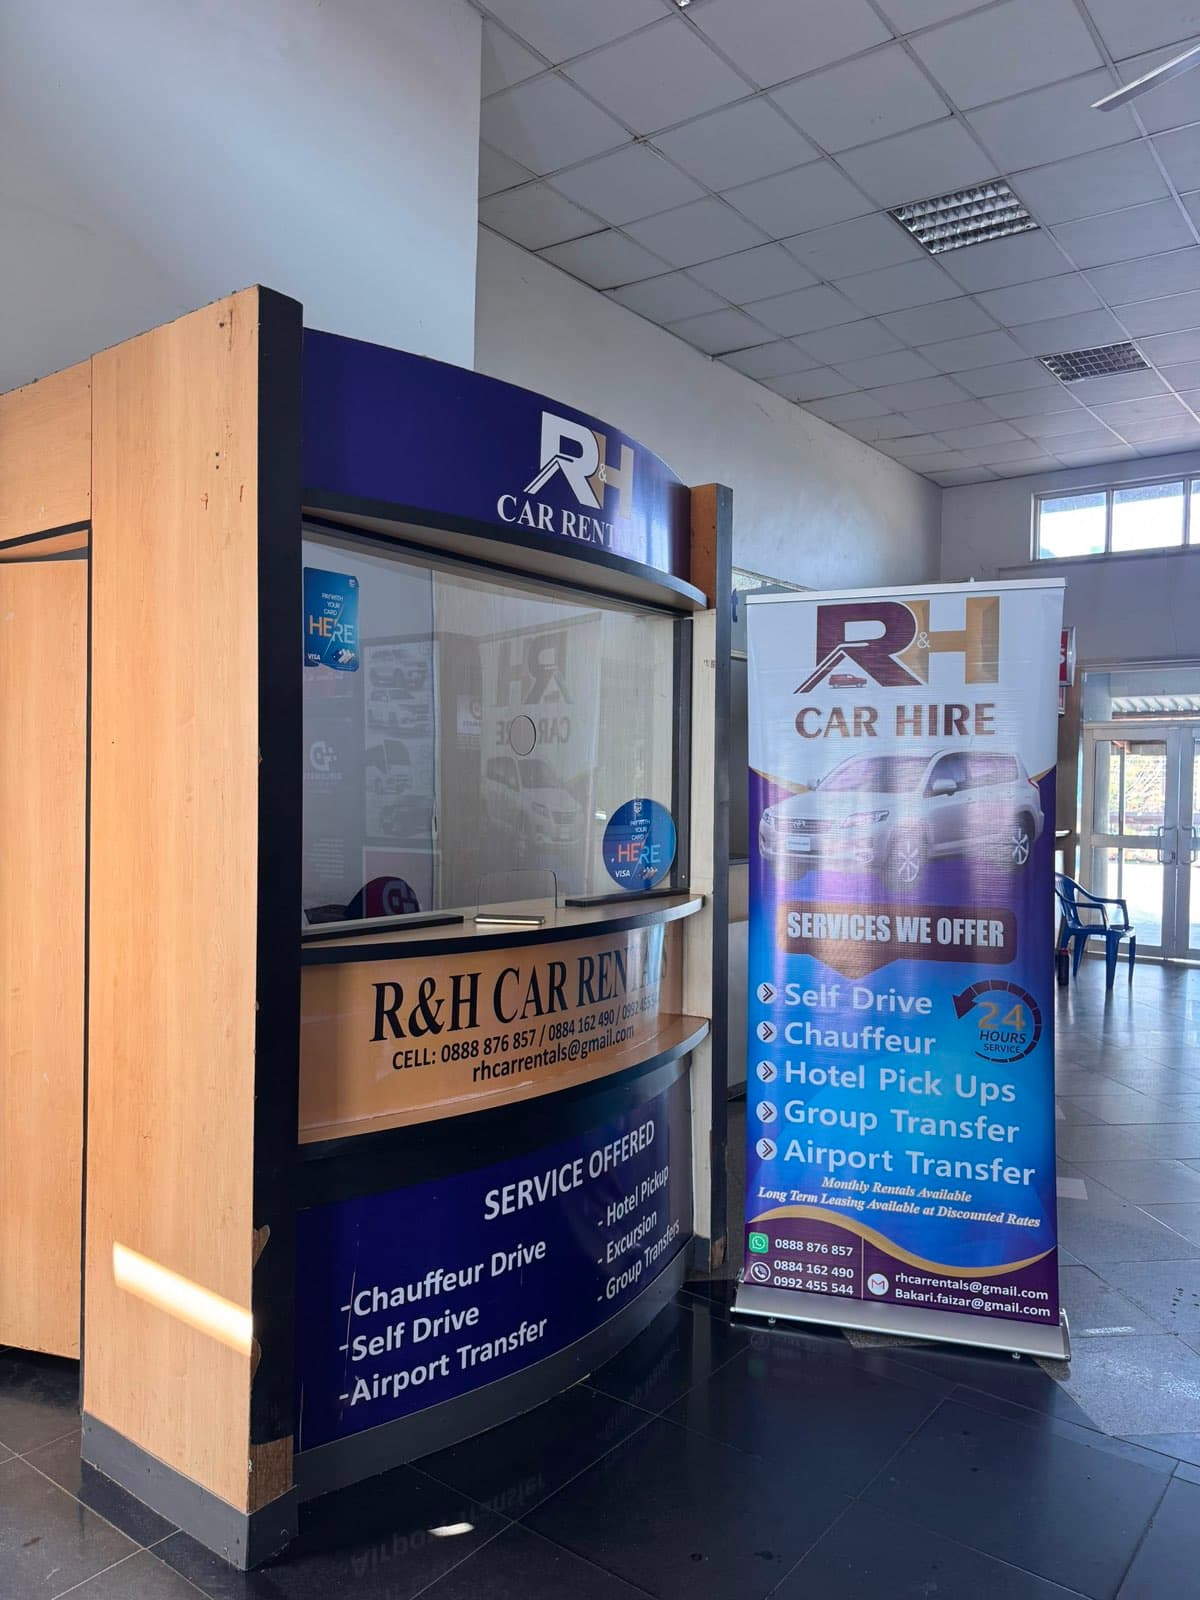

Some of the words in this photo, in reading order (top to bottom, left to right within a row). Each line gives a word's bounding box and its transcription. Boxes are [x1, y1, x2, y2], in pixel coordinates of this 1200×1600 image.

[497, 494, 555, 533] CAR
[309, 614, 356, 644] HERE
[793, 596, 1000, 694] R&H
[795, 706, 879, 739] CAR
[895, 703, 996, 737] HIRE
[617, 843, 661, 864] HERE
[615, 869, 631, 878] VISA
[787, 912, 891, 942] SERVICES
[896, 916, 931, 943] WE
[937, 918, 1005, 948] OFFER
[370, 972, 482, 1042] R&H
[493, 961, 568, 1023] CAR
[784, 983, 840, 1008] Self
[853, 986, 933, 1015] Drive
[978, 1002, 1027, 1031] 24
[392, 1048, 437, 1071] CELL:
[441, 1039, 479, 1064] 0888
[483, 1033, 509, 1056] 876
[513, 1029, 537, 1051] 857
[548, 1020, 576, 1042] 0884
[578, 1015, 596, 1033] 162
[599, 1009, 614, 1027] 490
[473, 1024, 635, 1082] rhcarrentals@gmail.com
[784, 1021, 936, 1055] Chauffeur
[979, 1030, 1027, 1044] HOURS
[984, 1043, 1021, 1053] SERVICE
[784, 1060, 865, 1089] Hotel
[879, 1068, 942, 1096] Pick
[954, 1073, 1017, 1106] Ups
[784, 1100, 878, 1136] Group
[890, 1109, 1020, 1144] Transfer
[484, 1158, 584, 1221] SERVICE
[588, 1119, 655, 1178] OFFERED
[784, 1139, 893, 1173] Airport
[905, 1150, 1036, 1186] Transfer
[607, 1185, 639, 1227] Hotel
[641, 1165, 669, 1202] Pickup
[758, 1186, 788, 1203] Long
[789, 1190, 818, 1203] Term
[820, 1193, 866, 1211] Leasing
[867, 1198, 920, 1215] Available
[922, 1206, 935, 1216] at
[936, 1206, 1005, 1224] Discounted
[1005, 1213, 1041, 1228] Rates
[821, 1176, 870, 1194] Monthly
[872, 1182, 915, 1196] Rentals
[917, 1187, 973, 1203] Available
[607, 1211, 657, 1264] Excursion
[775, 1238, 804, 1251] 0888
[806, 1241, 829, 1254] 876
[831, 1244, 854, 1257] 857
[491, 1241, 547, 1278] Drive
[606, 1259, 642, 1300] Group
[644, 1219, 680, 1268] Transfers
[773, 1259, 804, 1273] 0884
[806, 1263, 829, 1276] 162
[831, 1266, 855, 1279] 490
[773, 1275, 804, 1289] 0992
[806, 1279, 829, 1292] 455
[831, 1282, 855, 1296] 544
[895, 1273, 1049, 1301] rhcarrentals@gmail.com
[895, 1288, 1051, 1318] Bakari.faizar@gmail.com
[412, 1306, 480, 1344] Drive
[456, 1318, 548, 1372] Transfer
